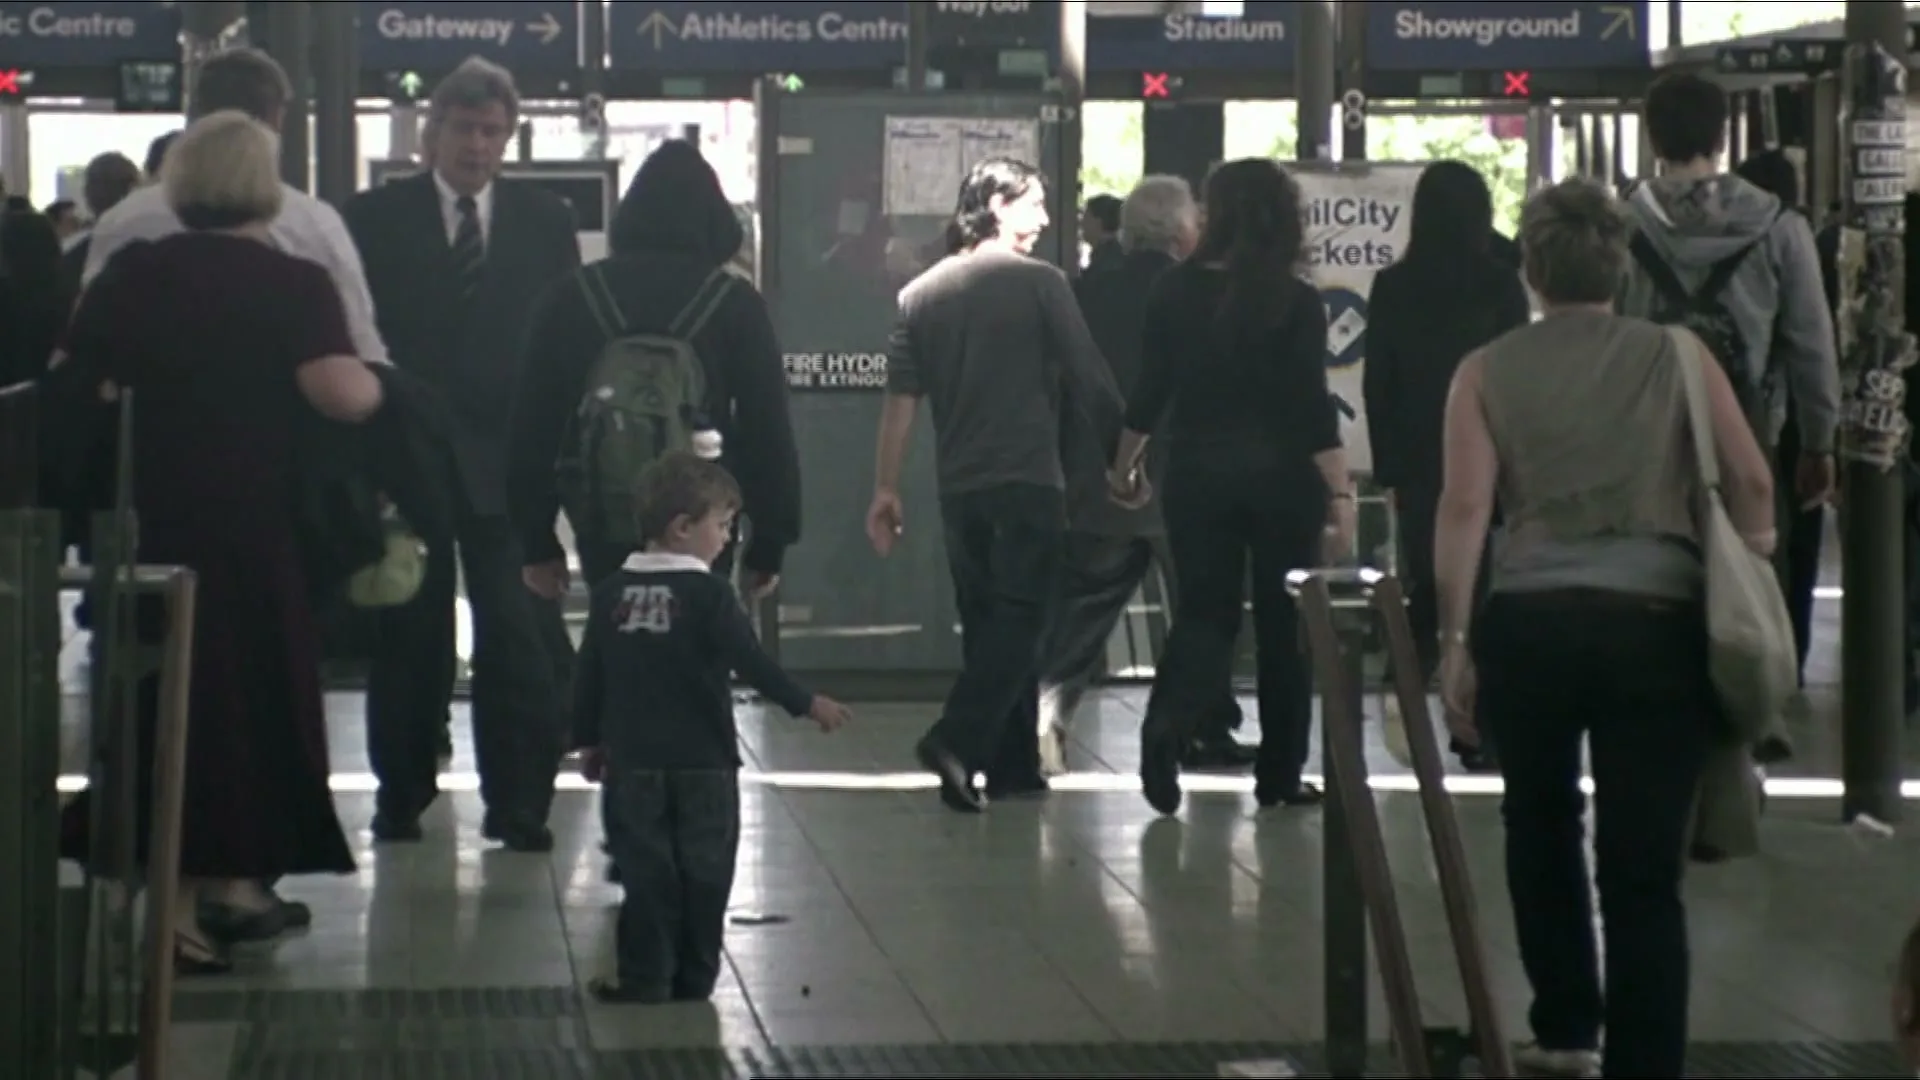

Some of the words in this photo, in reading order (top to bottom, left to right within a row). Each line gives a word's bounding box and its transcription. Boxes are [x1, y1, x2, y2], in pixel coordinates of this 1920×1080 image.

[28, 6, 136, 37] Centre
[377, 8, 515, 46] Gateway
[680, 11, 812, 42] Athletics
[1164, 11, 1285, 42] Stadium
[1395, 9, 1580, 46] Showground
[783, 352, 824, 373] FIRE
[828, 352, 888, 373] HYDR
